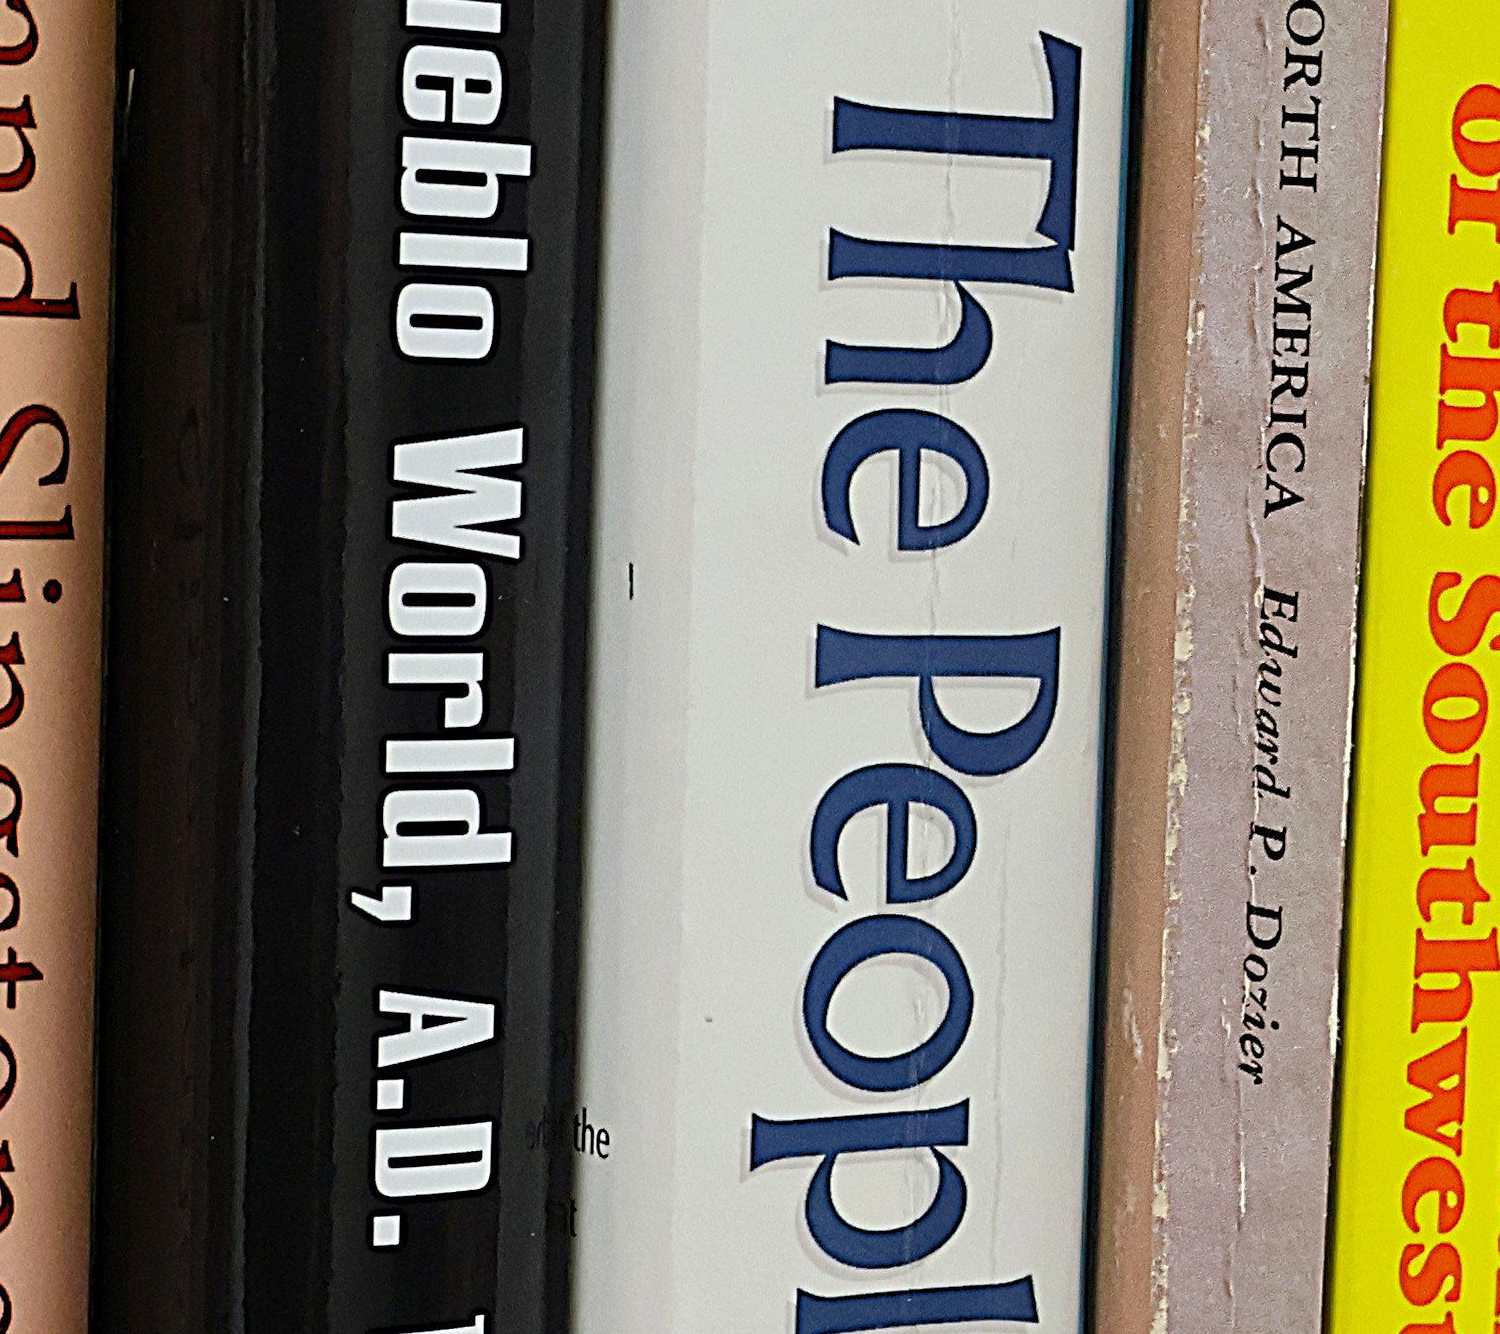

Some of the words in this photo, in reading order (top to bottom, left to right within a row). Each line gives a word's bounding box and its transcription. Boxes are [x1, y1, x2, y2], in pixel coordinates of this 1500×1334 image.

[819, 29, 1082, 552] The
[1263, 216, 1317, 518] AMERICA
[348, 426, 526, 925] World,
[1250, 583, 1300, 800] Edward
[1246, 822, 1289, 877] P.
[370, 988, 495, 1248] A.D.
[1238, 903, 1284, 1084] Dozier
